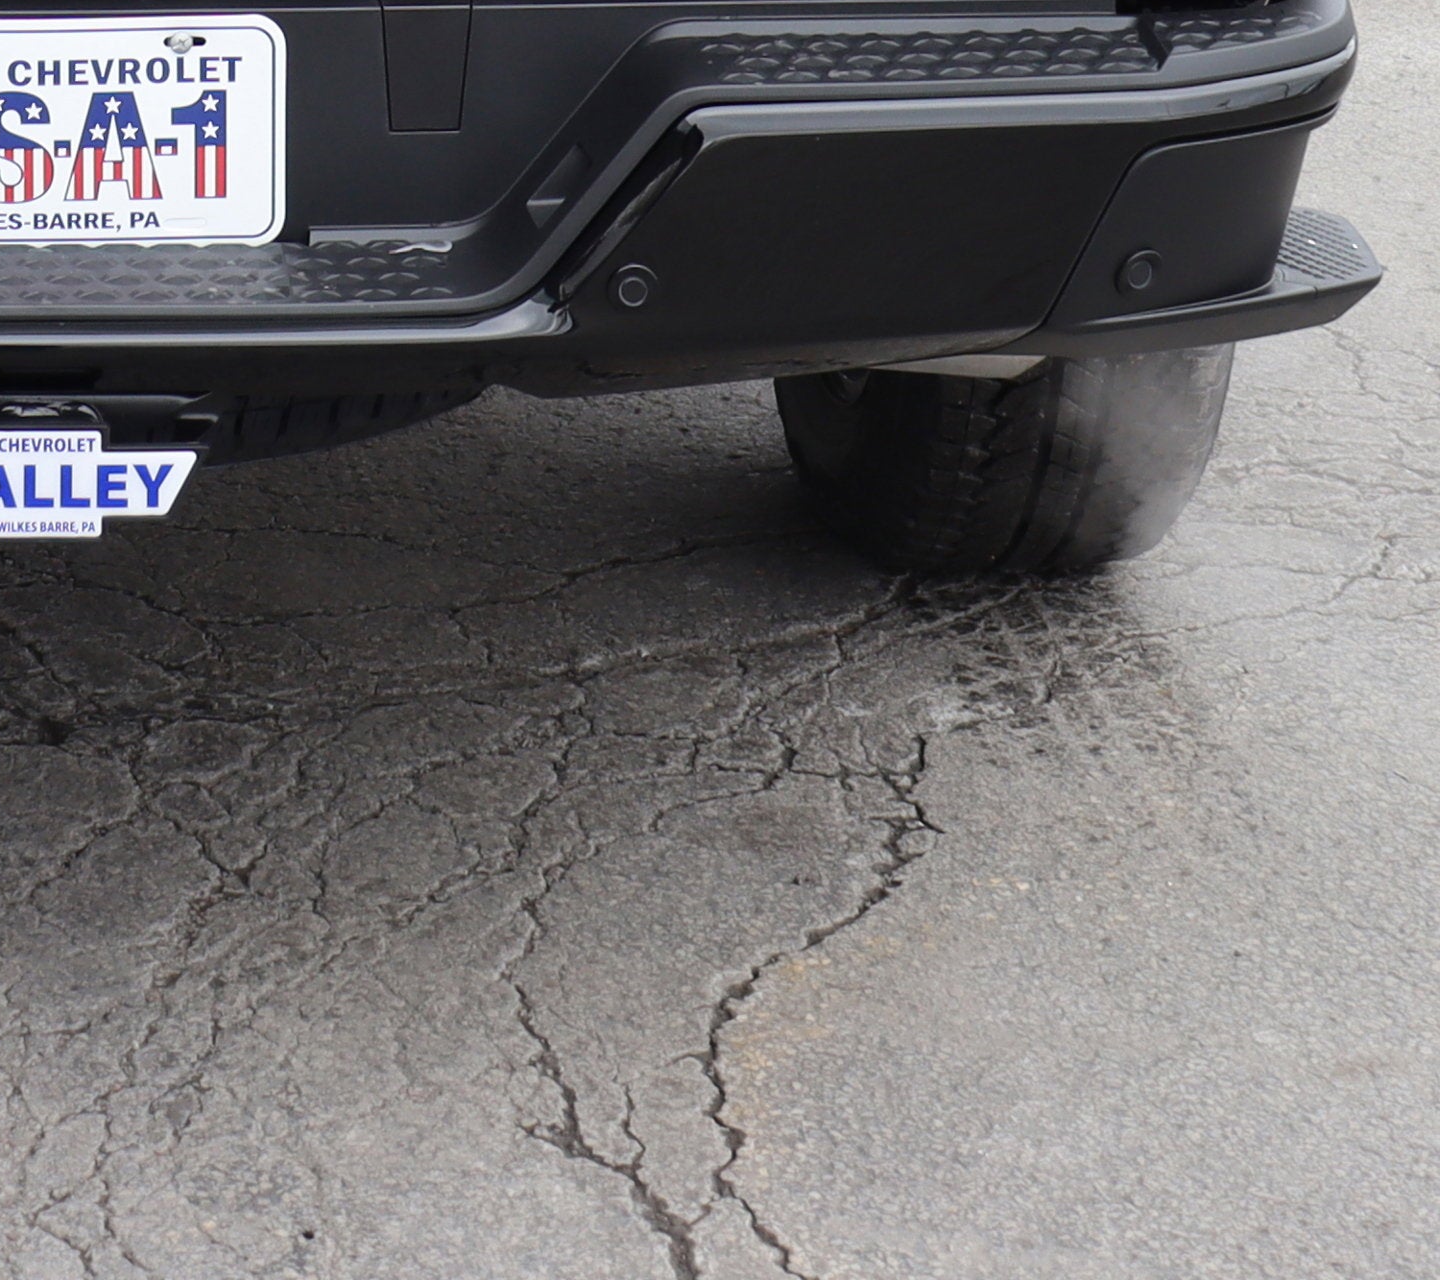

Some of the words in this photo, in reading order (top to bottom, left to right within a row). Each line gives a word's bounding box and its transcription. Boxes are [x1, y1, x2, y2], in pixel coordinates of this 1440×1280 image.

[7, 56, 243, 86] CHEVROLET
[130, 212, 161, 229] PA
[40, 521, 79, 535] BARRE,
[82, 521, 96, 533] PA
